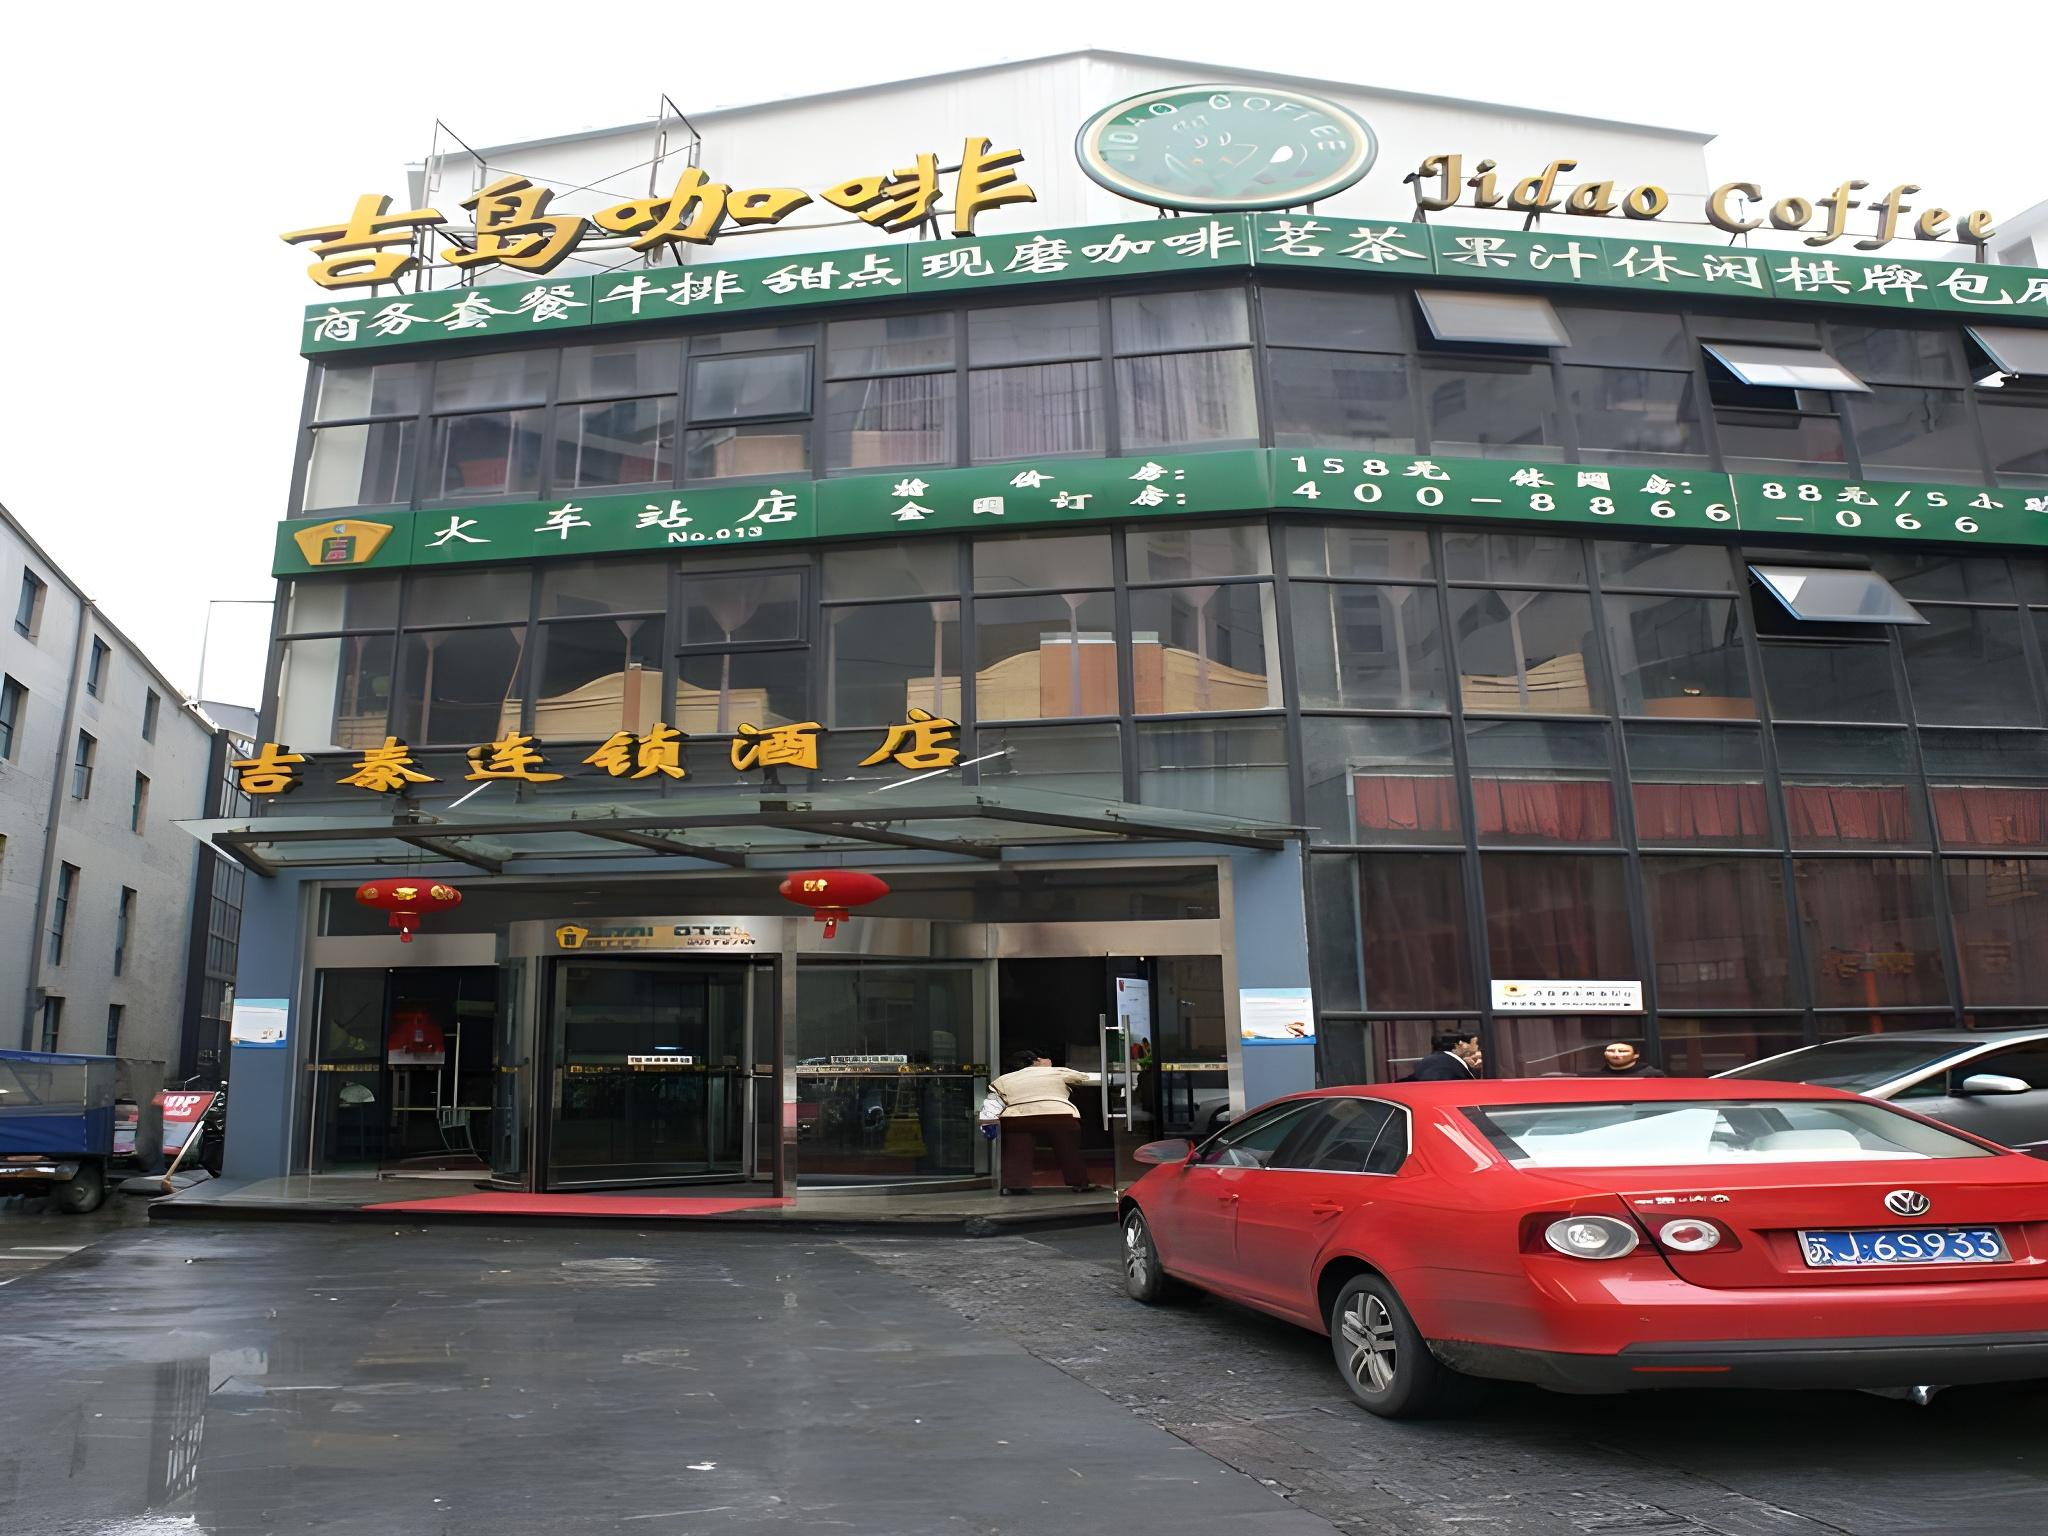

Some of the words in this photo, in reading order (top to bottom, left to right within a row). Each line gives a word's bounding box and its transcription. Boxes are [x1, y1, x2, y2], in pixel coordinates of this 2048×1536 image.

[279, 136, 1038, 291] 吉岛咖啡
[1416, 153, 1668, 221] Jidao
[1704, 180, 1996, 251] Coffee
[424, 489, 798, 548] 火车站店
[230, 708, 963, 795] 吉泰连锁酒店
